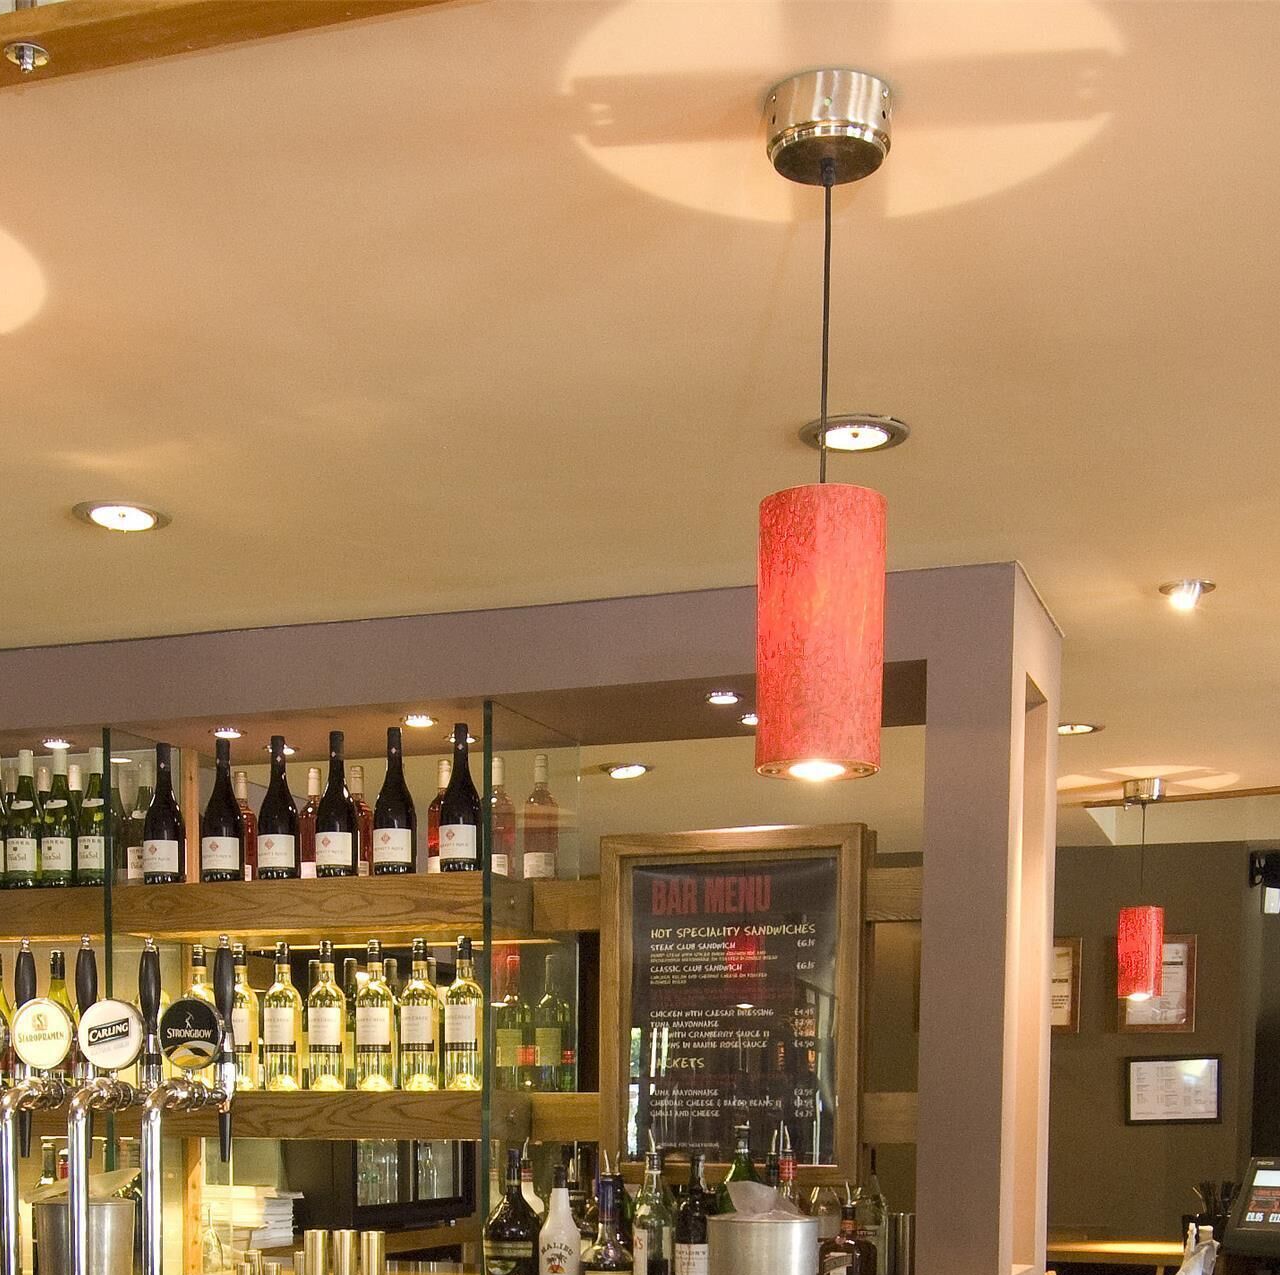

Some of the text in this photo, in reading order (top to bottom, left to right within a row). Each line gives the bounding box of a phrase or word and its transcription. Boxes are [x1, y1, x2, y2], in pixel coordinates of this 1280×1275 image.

[652, 875, 771, 915] BAR MENU
[651, 923, 816, 939] HOT SPECIALITY SANDWICHES
[650, 943, 673, 951] STEAK
[676, 942, 695, 950] CLUB
[697, 941, 736, 950] SANDWICH
[650, 965, 681, 973] CLASSIC
[683, 964, 702, 972] CLUB
[704, 963, 743, 972] SANDWICH
[650, 1010, 683, 1018] CHICKEN
[705, 1009, 735, 1017] CAESAR
[737, 1008, 774, 1017] DRESSING
[672, 1020, 719, 1028] MAYONNAISE
[89, 1021, 129, 1042] CARLING
[166, 1027, 212, 1039] STRONGBOW
[688, 1031, 734, 1039] CRANBERRY
[736, 1030, 761, 1038] SAUCE
[17, 1031, 64, 1043] STAROPRAMEN
[682, 1041, 691, 1049] IN
[720, 1041, 740, 1049] ROSE
[742, 1040, 768, 1048] SAUCE
[651, 1057, 705, 1070] ACKETS
[672, 1088, 719, 1096] MAYONNAISE
[686, 1099, 716, 1107] CHEESE
[749, 1098, 773, 1107] BEANS
[691, 1109, 720, 1117] CHEESE
[541, 1242, 574, 1256] MALIBU
